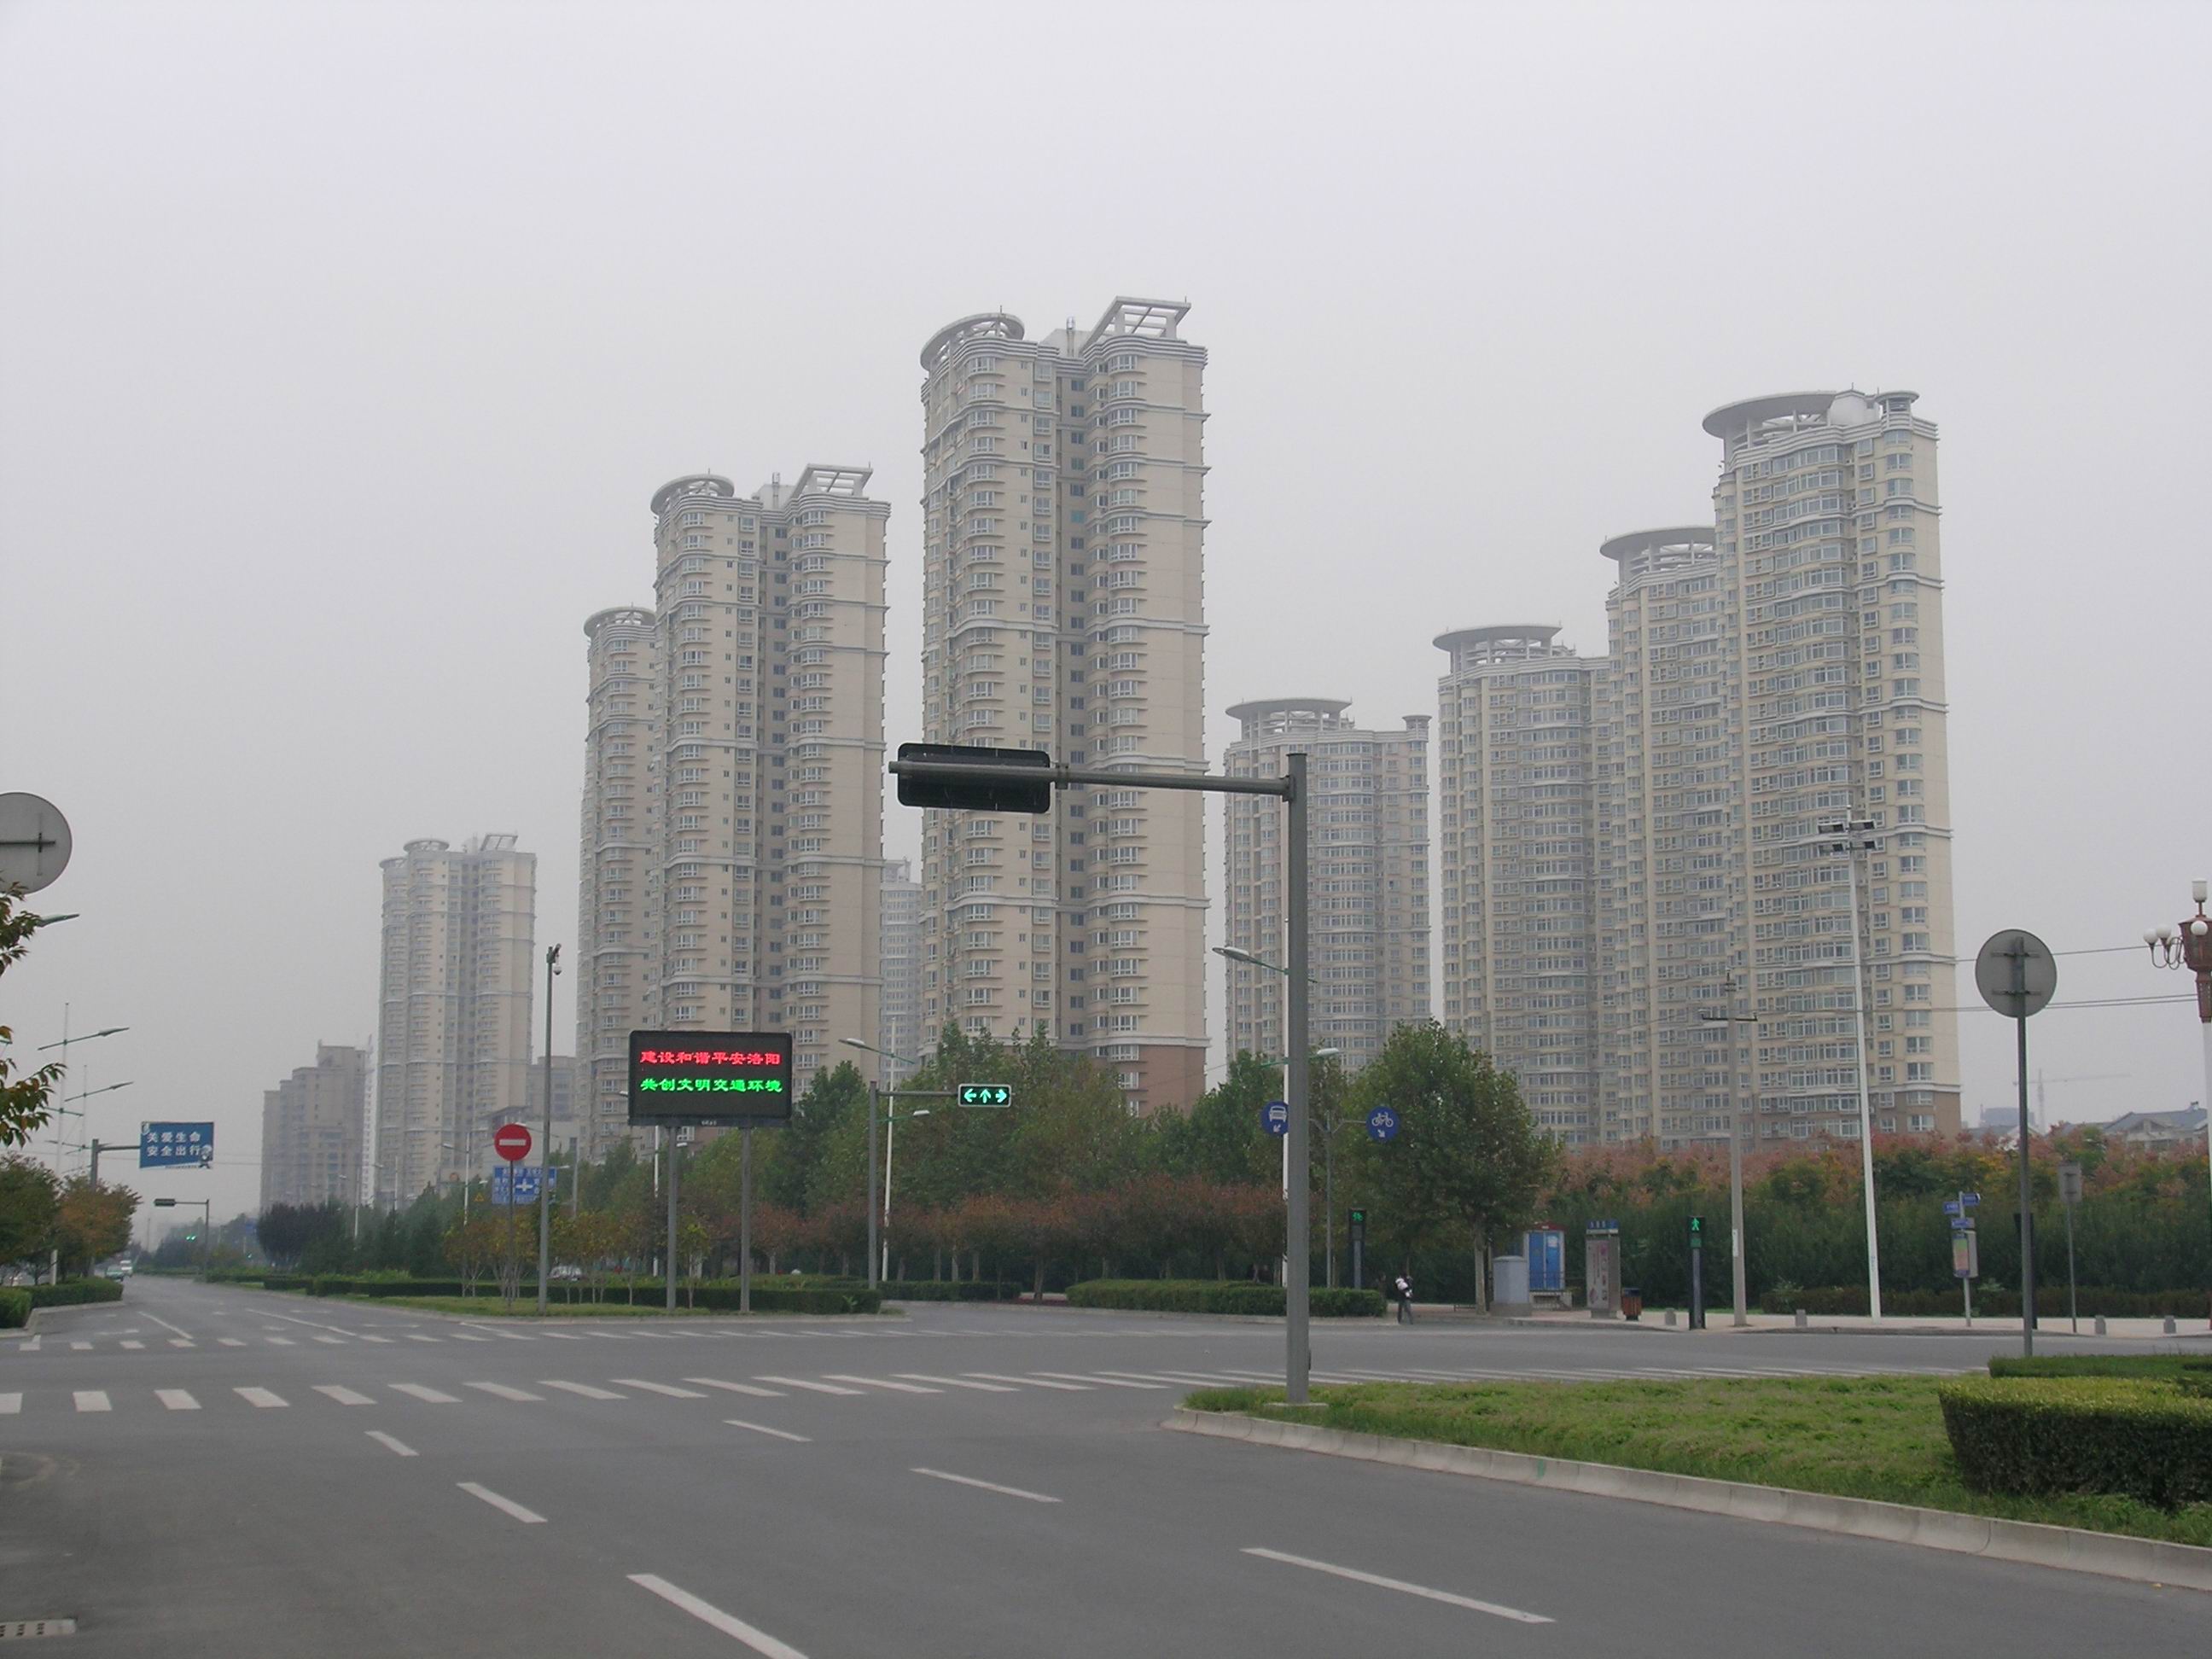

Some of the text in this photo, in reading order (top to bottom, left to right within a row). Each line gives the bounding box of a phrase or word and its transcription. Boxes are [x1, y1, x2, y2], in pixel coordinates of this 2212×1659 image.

[640, 1050, 782, 1065] 建设和谐平安洛阳
[640, 1078, 783, 1092] 共创文明交通环境
[147, 1132, 201, 1143] 关爱生命
[147, 1145, 201, 1156] 安全出行
